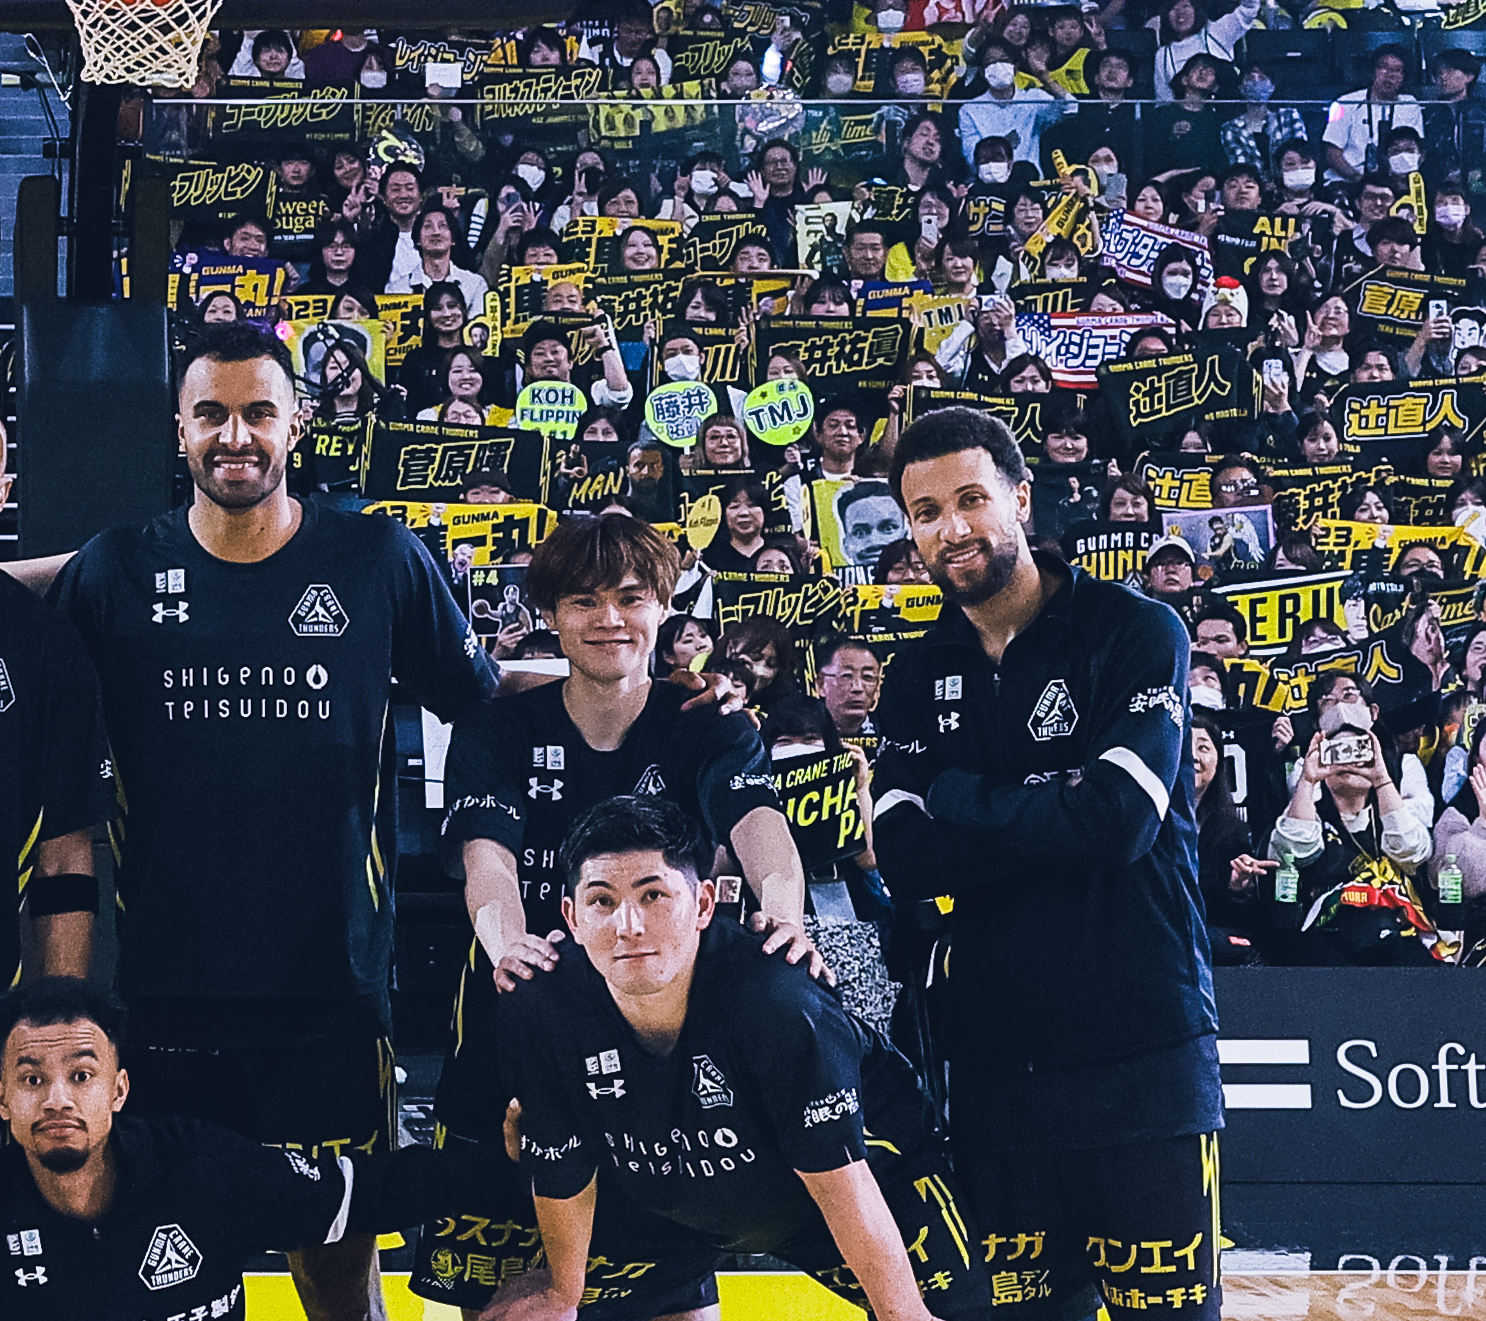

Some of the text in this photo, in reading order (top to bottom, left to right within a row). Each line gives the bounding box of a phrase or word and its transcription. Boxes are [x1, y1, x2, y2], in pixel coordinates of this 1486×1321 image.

[1254, 216, 1295, 237] ALL
[531, 389, 568, 405] KOH
[653, 391, 709, 422] 藤井
[748, 399, 809, 433] TMJ
[569, 470, 624, 508] MAN
[452, 511, 499, 526] GUNMA
[472, 570, 498, 586] #4
[787, 762, 829, 788] CRANE
[982, 1231, 1045, 1262] ナガ
